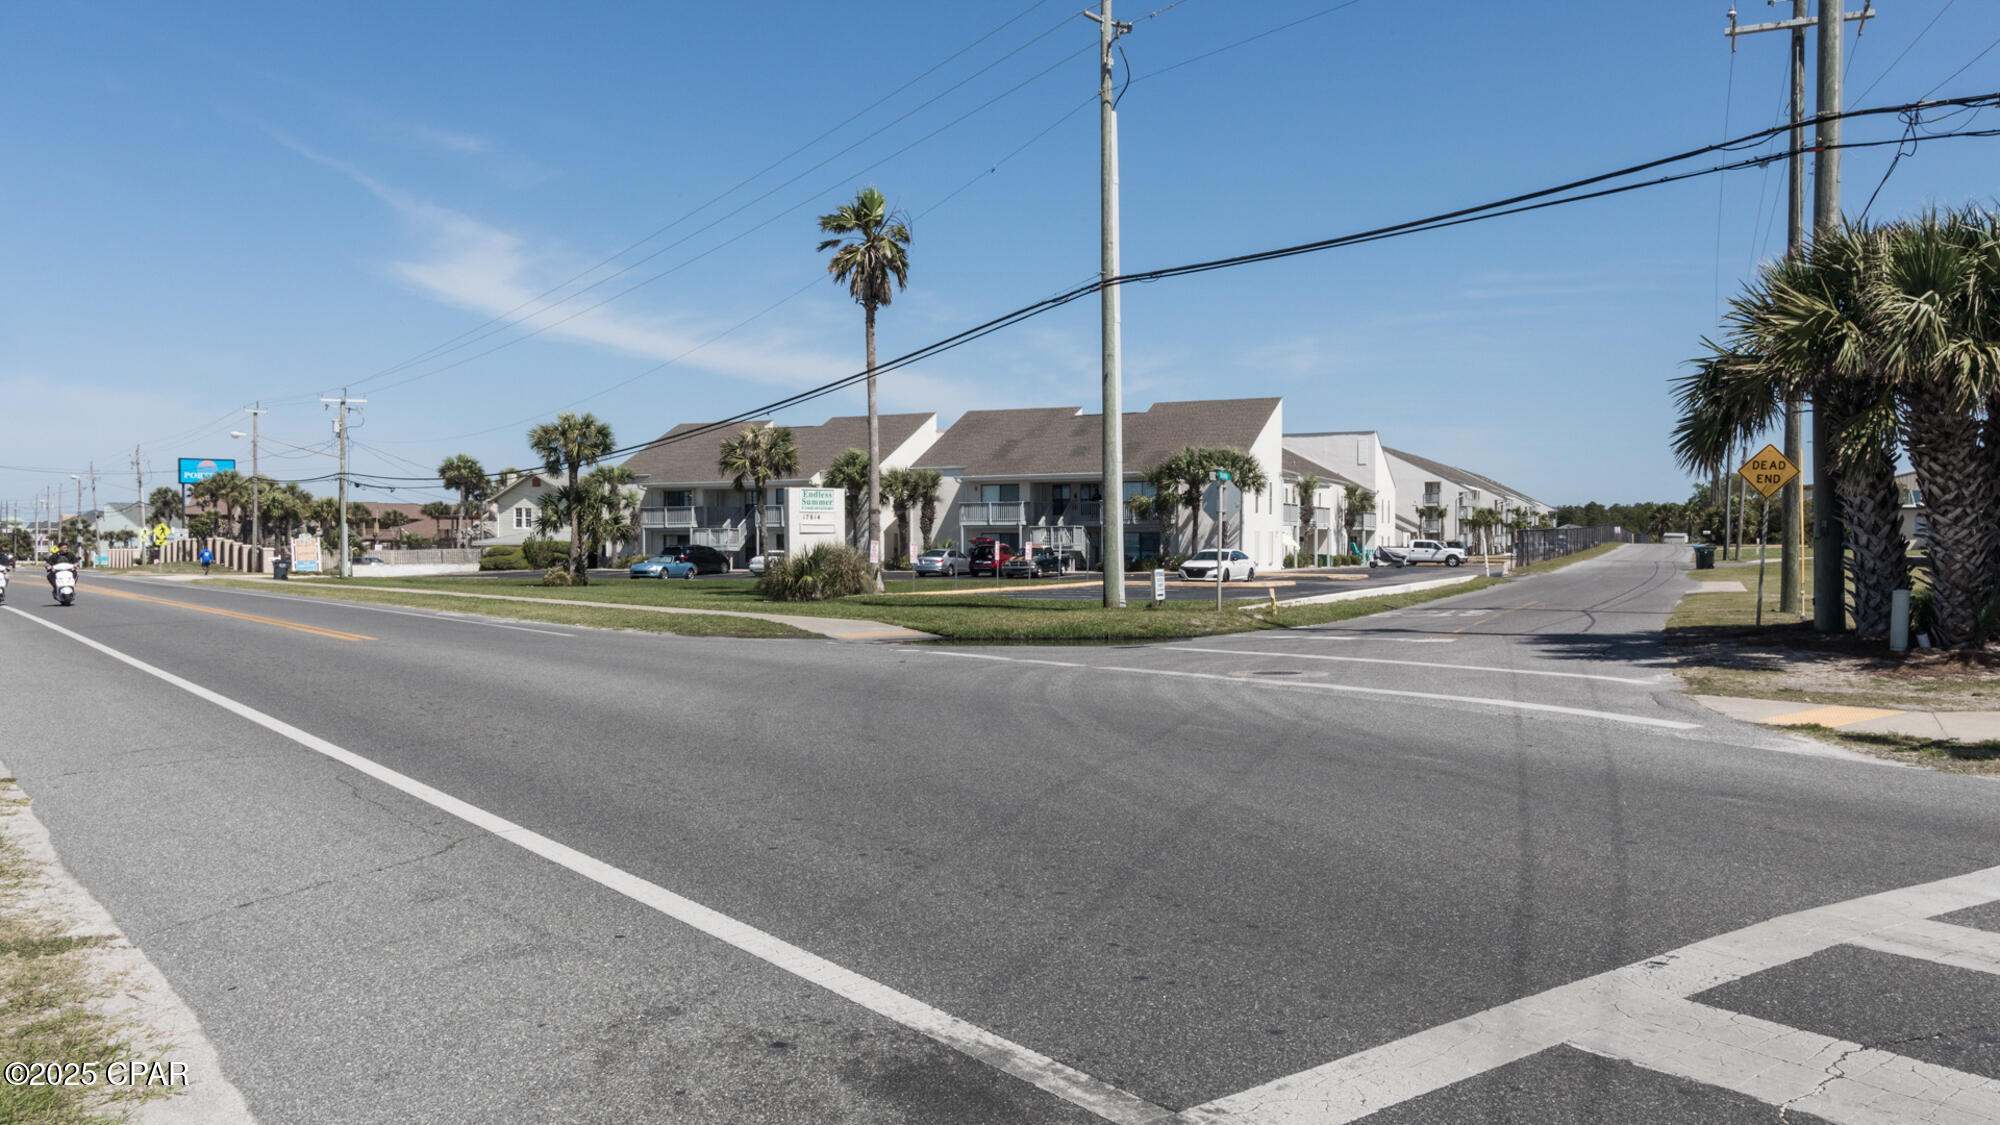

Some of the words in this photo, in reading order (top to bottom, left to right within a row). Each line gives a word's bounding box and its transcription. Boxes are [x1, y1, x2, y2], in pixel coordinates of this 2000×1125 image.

[1752, 460, 1786, 470] DEAD
[1756, 474, 1781, 484] END
[802, 489, 833, 498] Endless
